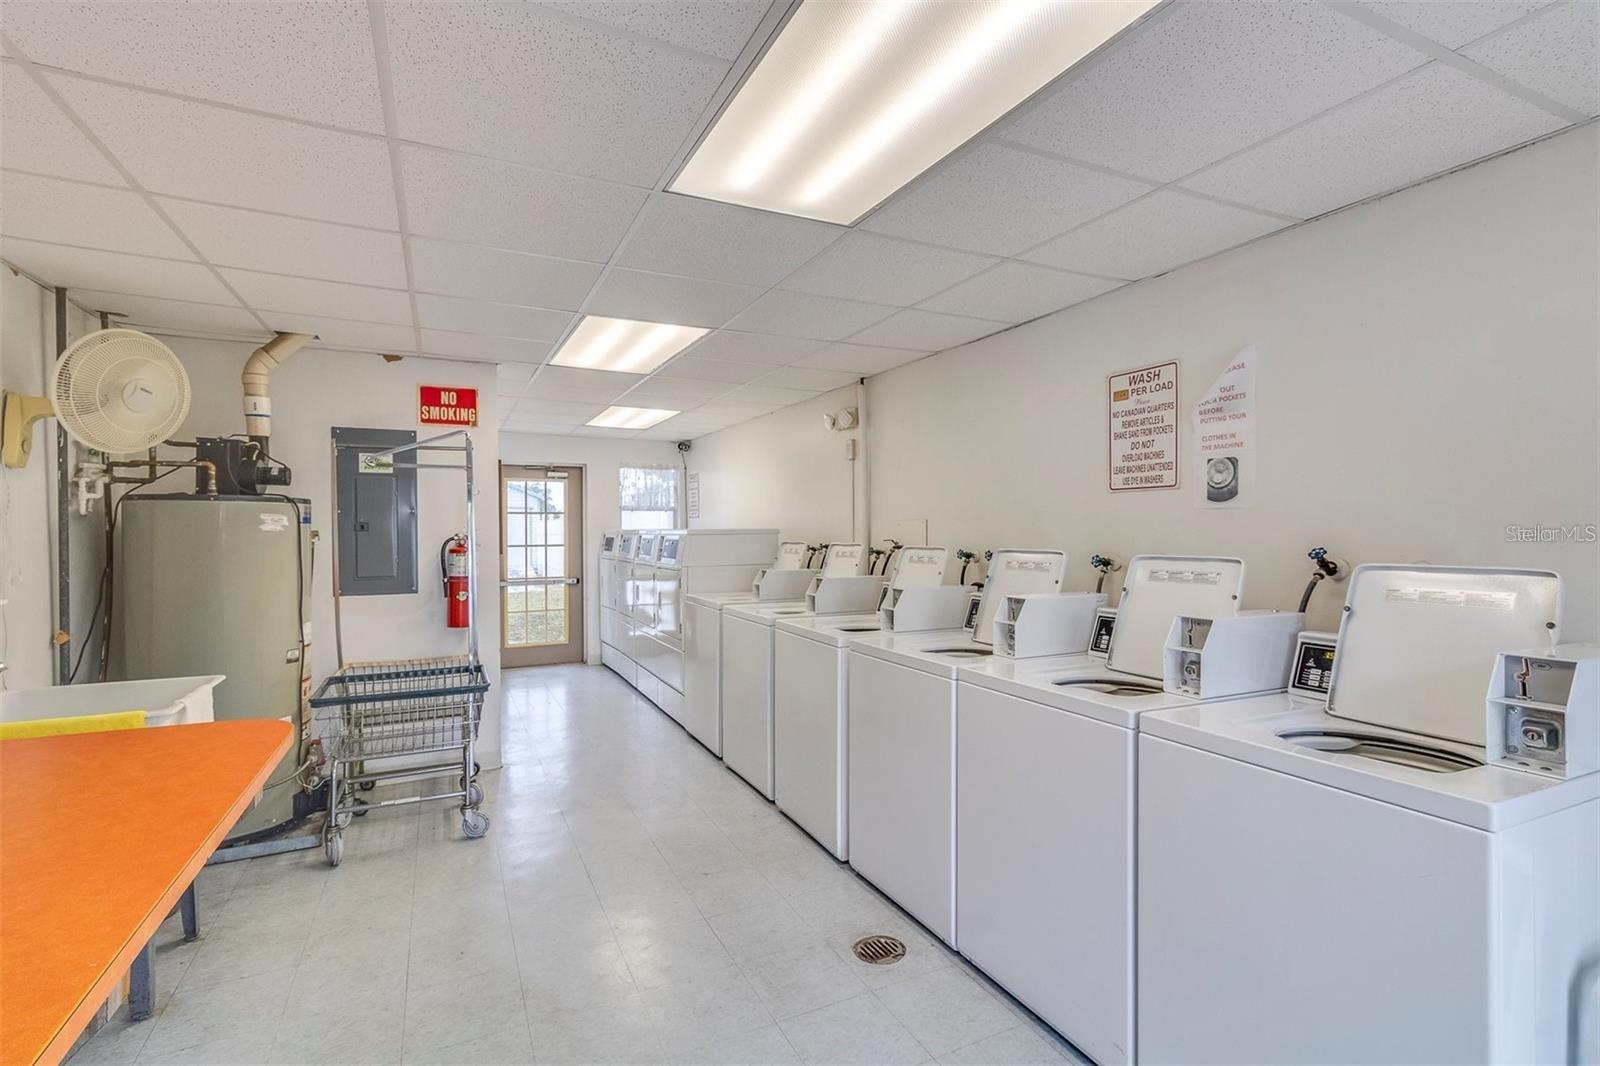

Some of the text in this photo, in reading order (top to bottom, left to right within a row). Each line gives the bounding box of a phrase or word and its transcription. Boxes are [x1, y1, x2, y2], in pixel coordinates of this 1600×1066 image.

[1128, 370, 1161, 386] WASH
[1131, 386, 1147, 397] PER
[1149, 380, 1174, 393] LOAD
[1220, 385, 1234, 393] OUT
[440, 391, 457, 406] NO
[1219, 393, 1246, 402] POCKETS
[421, 405, 476, 422] SMOKING
[1121, 408, 1146, 417] CANADIAN
[1147, 402, 1174, 414] QUARTERS
[1199, 406, 1223, 415] BEFORE
[1122, 419, 1139, 429] REMOVE
[1140, 415, 1160, 426] ARTICLES
[1200, 412, 1246, 424] PUTTING YOUR
[1113, 424, 1173, 440] SHAKE SAND FROM POCKETS
[1201, 434, 1229, 442] CLOTHES
[1130, 439, 1155, 451] DO NOT
[1214, 441, 1244, 450] MACHINE
[1122, 450, 1164, 462] OVERLOAD MACHINES
[1113, 462, 1173, 475] LEAVE MACHINES UNATTENDED
[1122, 476, 1130, 486] USE
[1130, 476, 1139, 486] DYE
[1144, 474, 1164, 484] WASHERS
